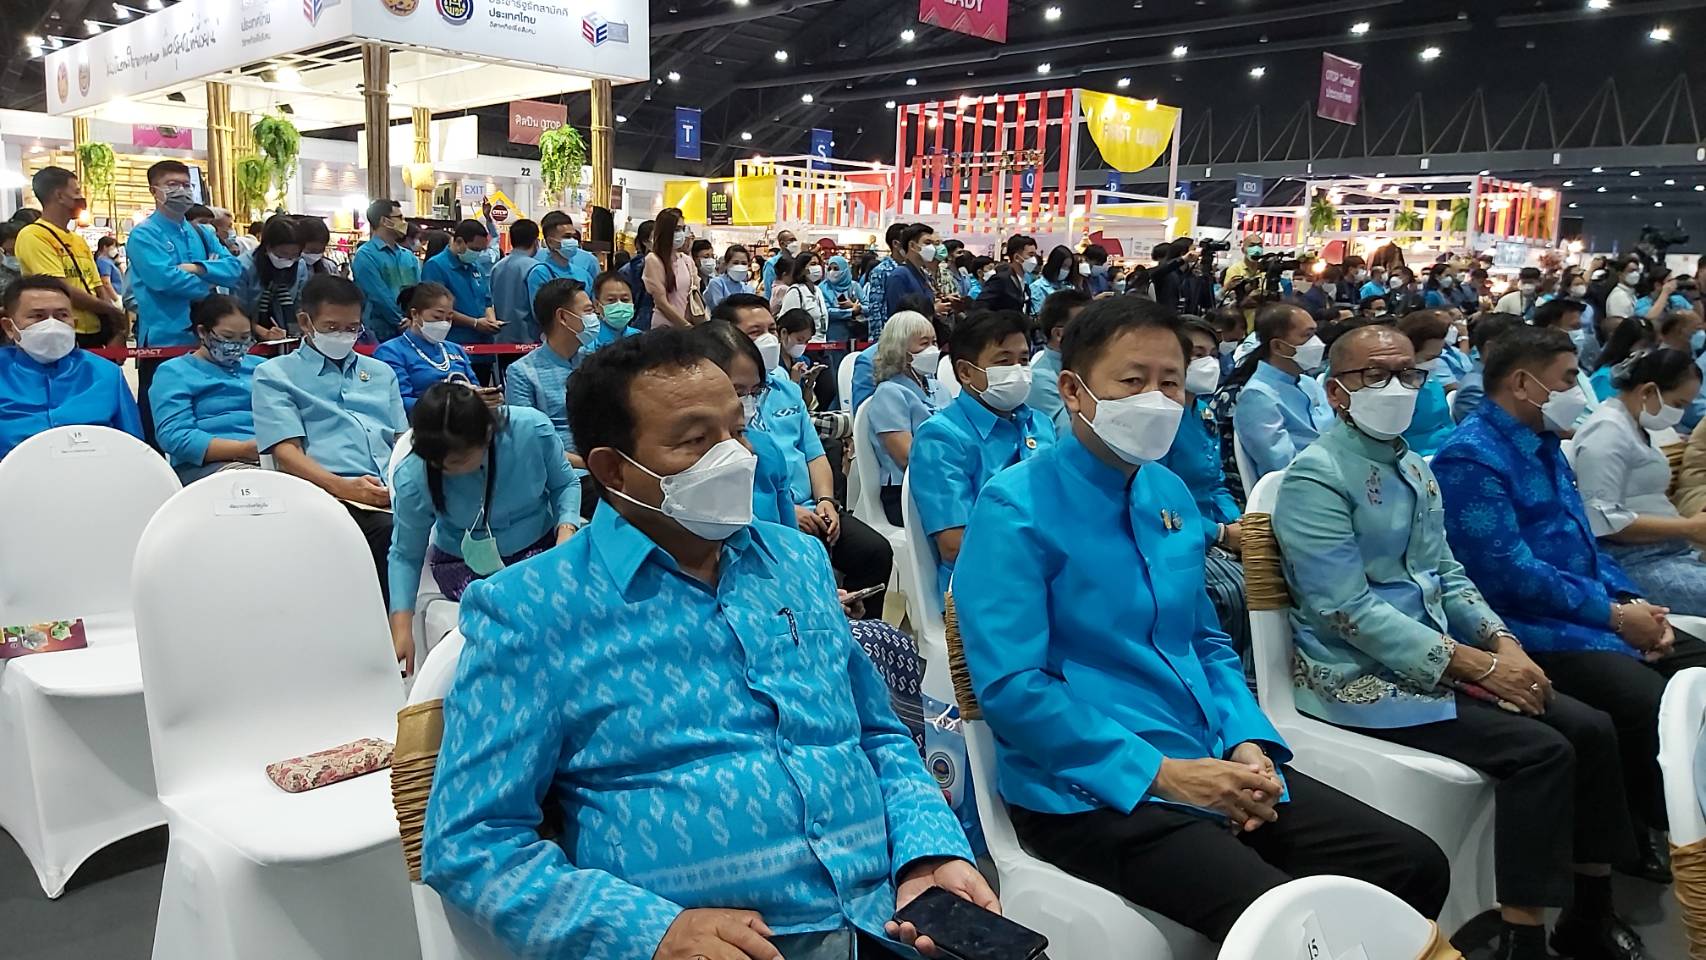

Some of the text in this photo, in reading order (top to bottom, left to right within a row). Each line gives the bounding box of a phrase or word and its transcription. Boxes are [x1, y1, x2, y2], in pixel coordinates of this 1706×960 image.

[488, 7, 537, 25] ประเทศไทย
[682, 124, 694, 143] T
[521, 167, 531, 177] 22
[464, 184, 485, 195] EXIT
[240, 488, 252, 497] 15
